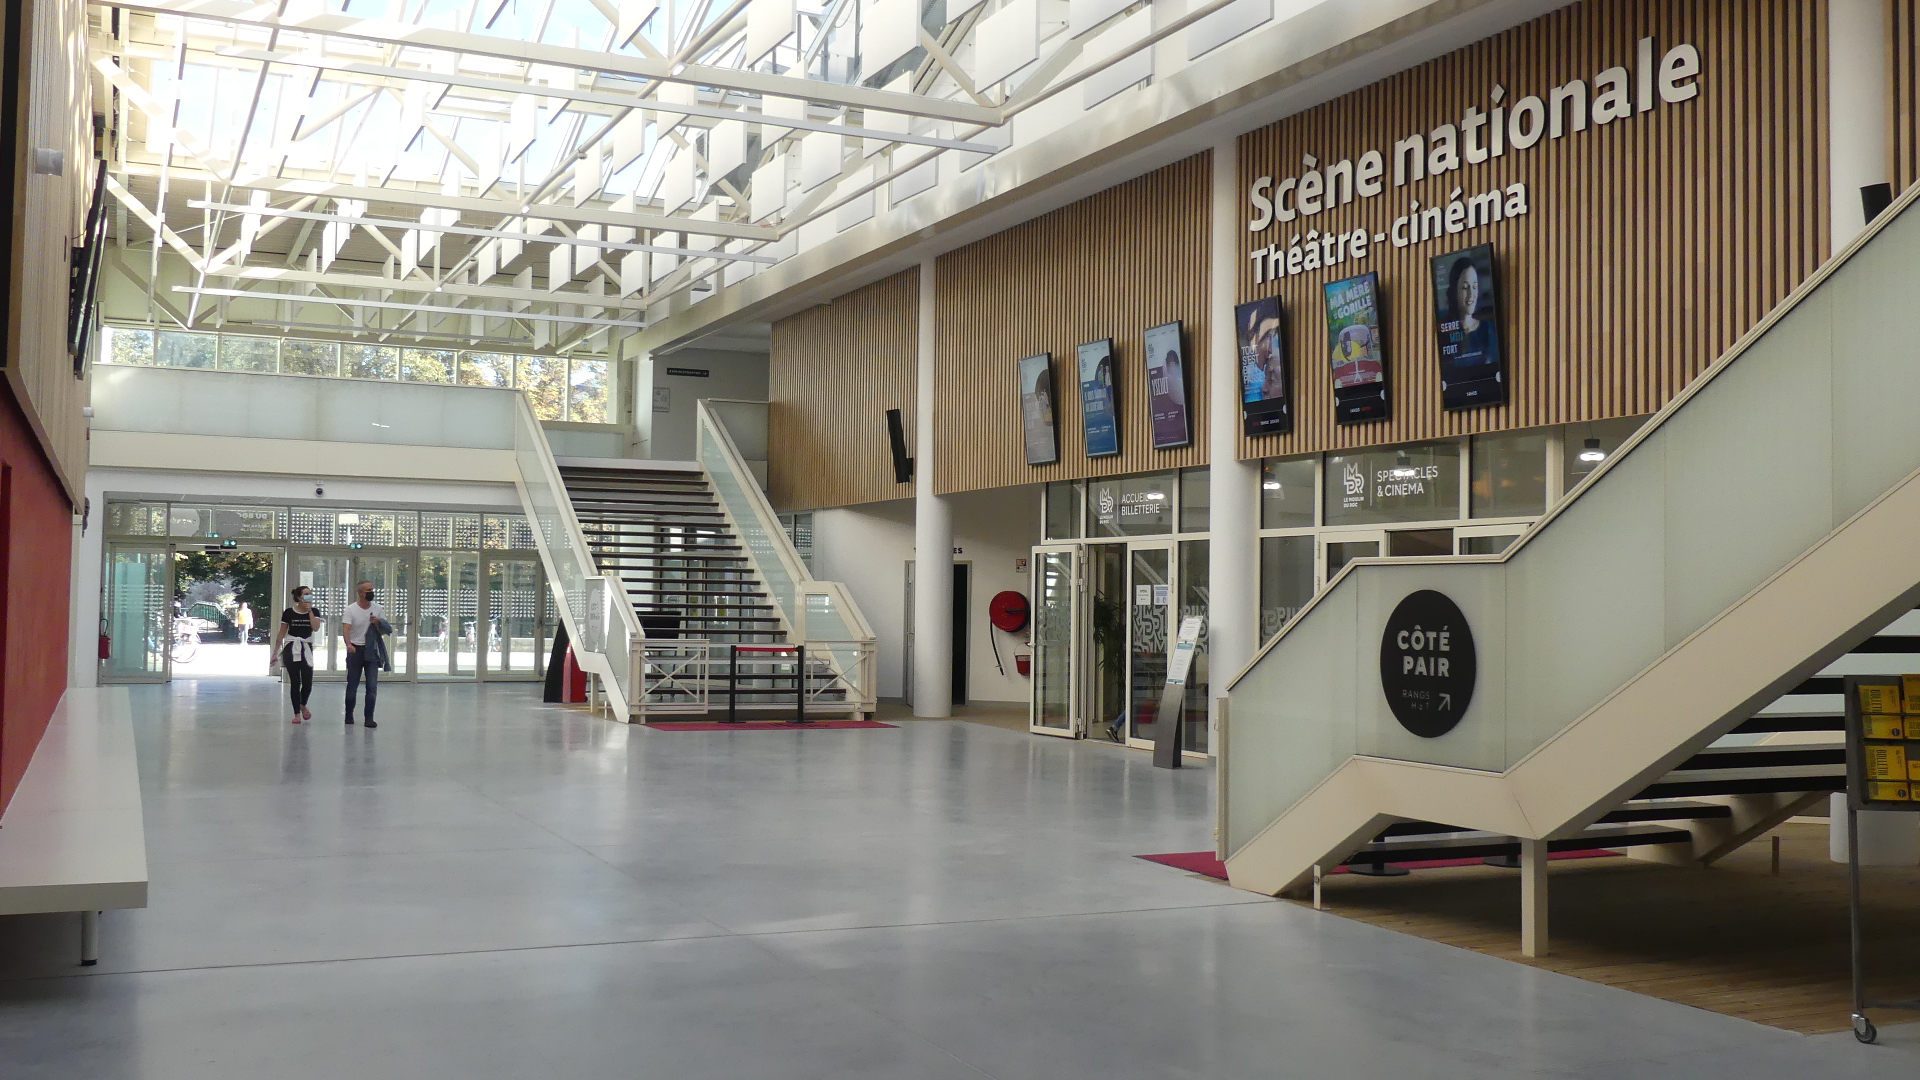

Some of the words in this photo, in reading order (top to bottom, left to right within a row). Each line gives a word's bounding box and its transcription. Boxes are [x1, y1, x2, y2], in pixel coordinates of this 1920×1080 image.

[1250, 153, 1383, 232] Scène
[1394, 36, 1701, 187] nationale
[1250, 227, 1368, 284] Théâtre
[1391, 182, 1528, 248] cinéma
[1338, 295, 1372, 318] GORILLE
[1441, 321, 1459, 332] SERRE
[1241, 345, 1257, 356] TOUT
[1443, 344, 1458, 355] FORT
[1377, 485, 1383, 497] &
[1384, 480, 1424, 497] CINÉMA
[1121, 503, 1160, 516] BILLETTERIE
[1396, 625, 1450, 651] CÔTÉ
[1402, 655, 1450, 677] PAIR
[1402, 690, 1430, 699] RANGS
